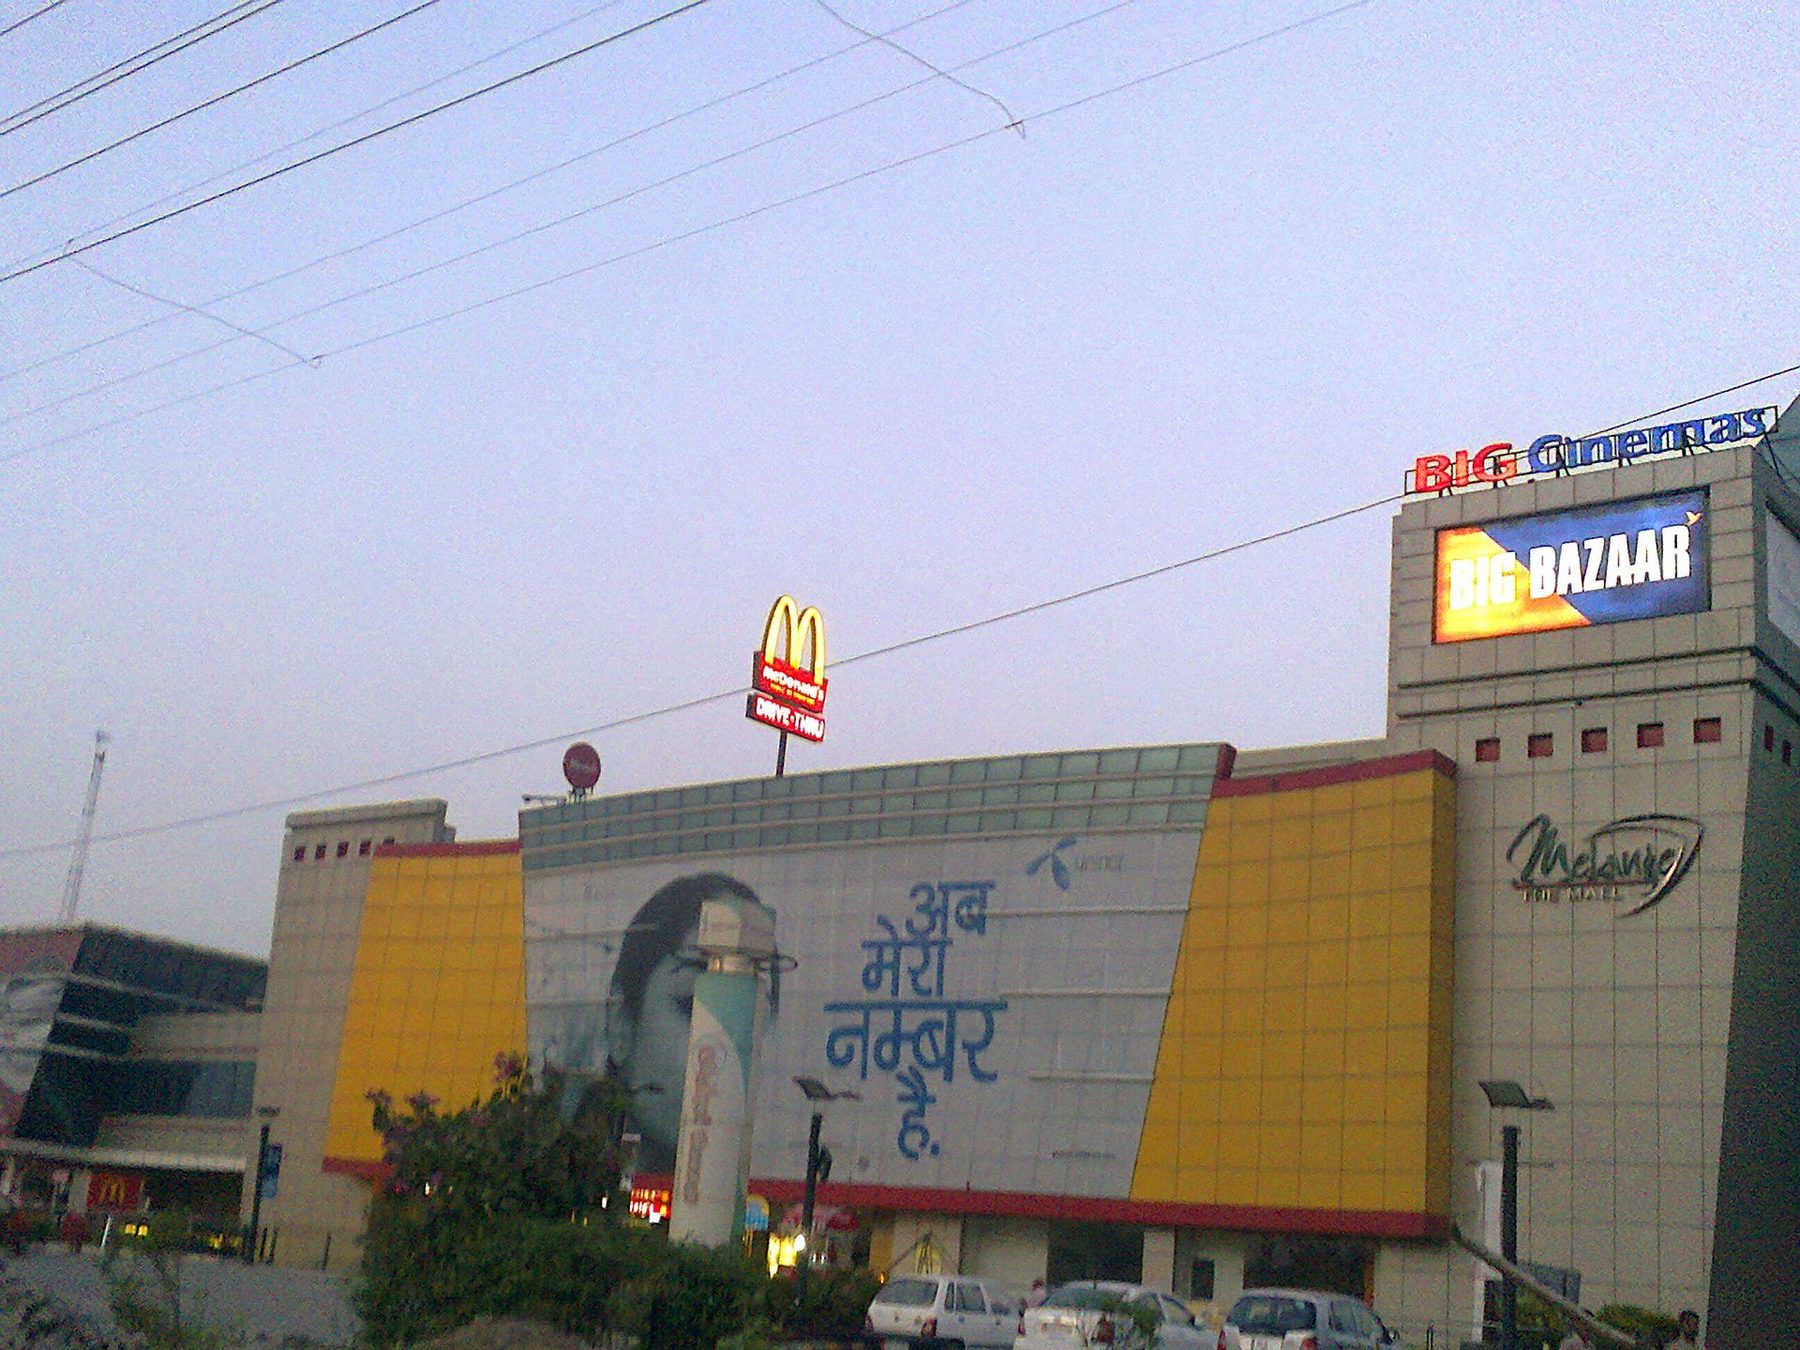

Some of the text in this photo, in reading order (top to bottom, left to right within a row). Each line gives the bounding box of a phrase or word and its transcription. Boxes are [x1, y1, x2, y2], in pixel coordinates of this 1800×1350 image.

[1414, 408, 1765, 494] BIG Cinemas
[1449, 525, 1692, 611] BIG BAZAAR
[905, 880, 996, 937] अब
[860, 914, 953, 997] मेरा
[823, 1000, 1009, 1084] नम्बर
